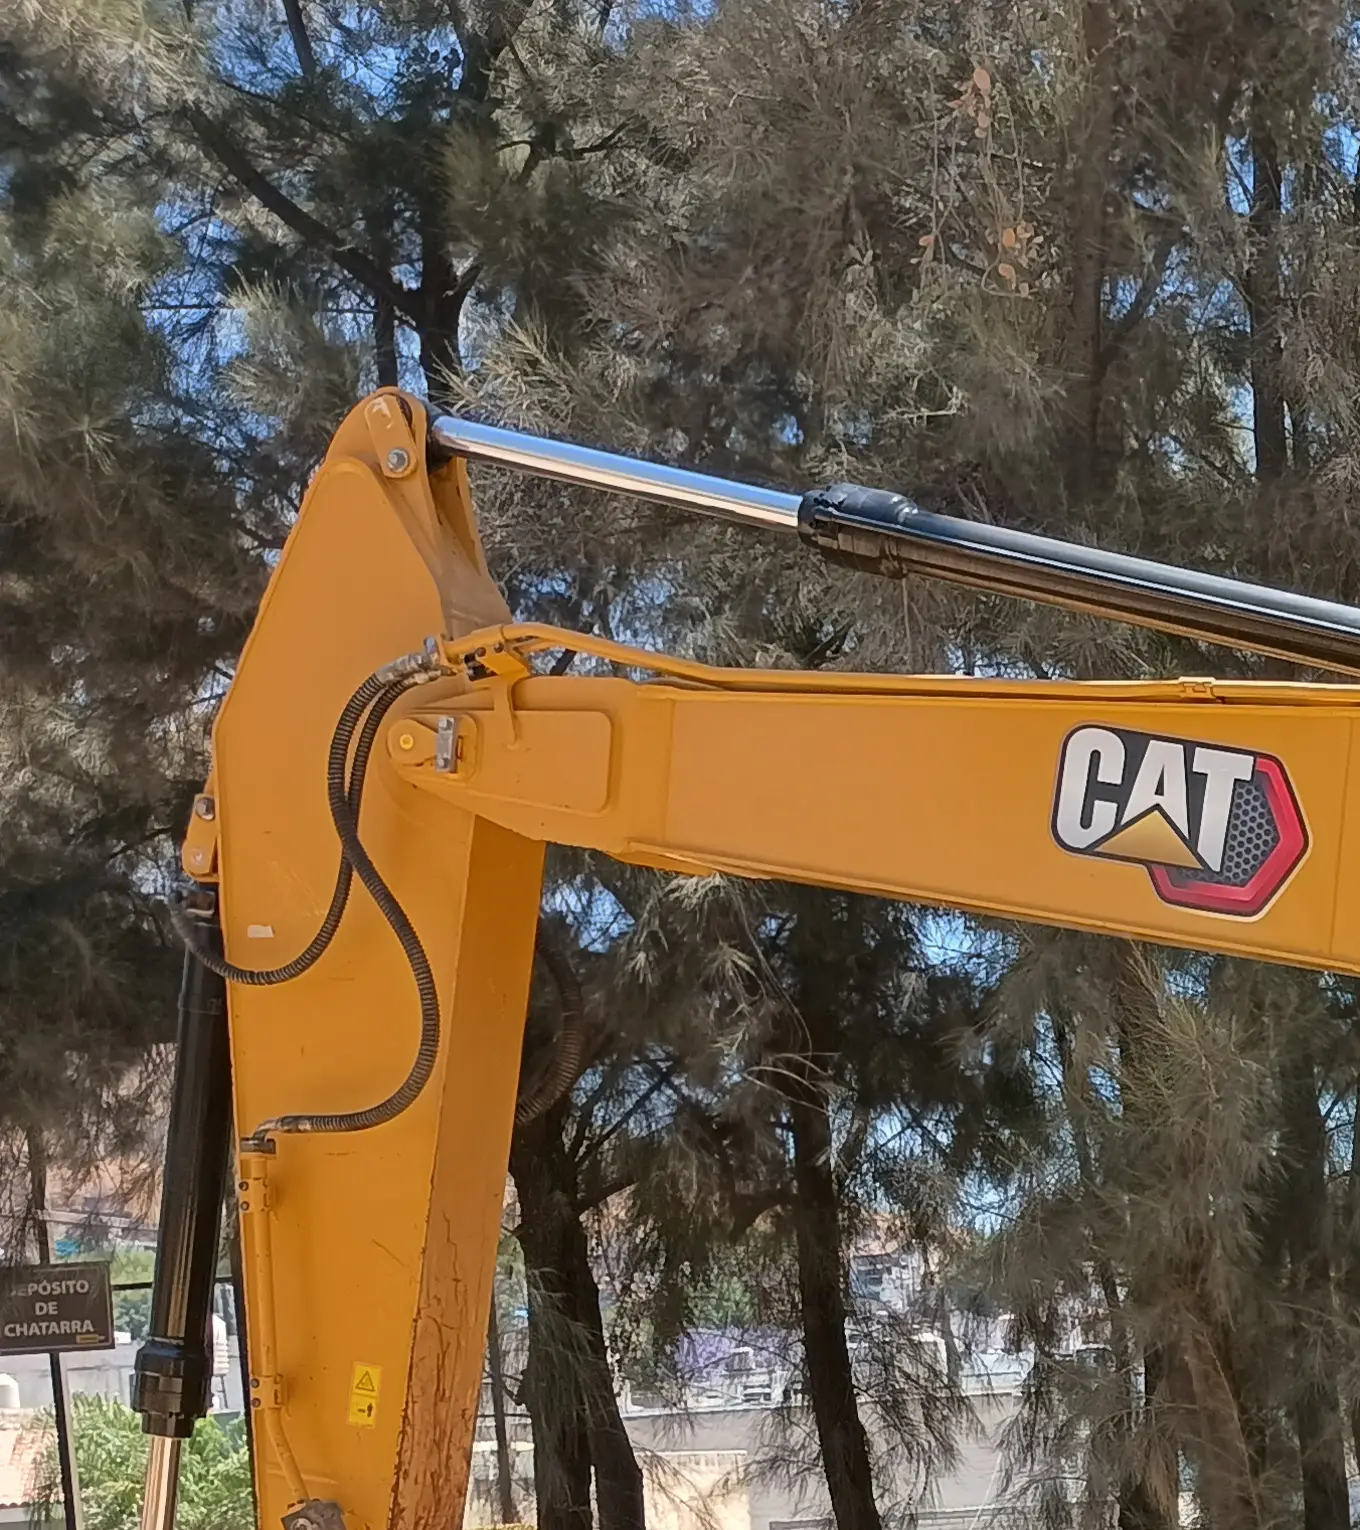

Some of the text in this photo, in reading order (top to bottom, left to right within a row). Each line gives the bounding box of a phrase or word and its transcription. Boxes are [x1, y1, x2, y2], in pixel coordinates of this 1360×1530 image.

[1056, 727, 1254, 873] CAT
[34, 1301, 59, 1316] DE
[4, 1319, 94, 1338] CHATARRA
